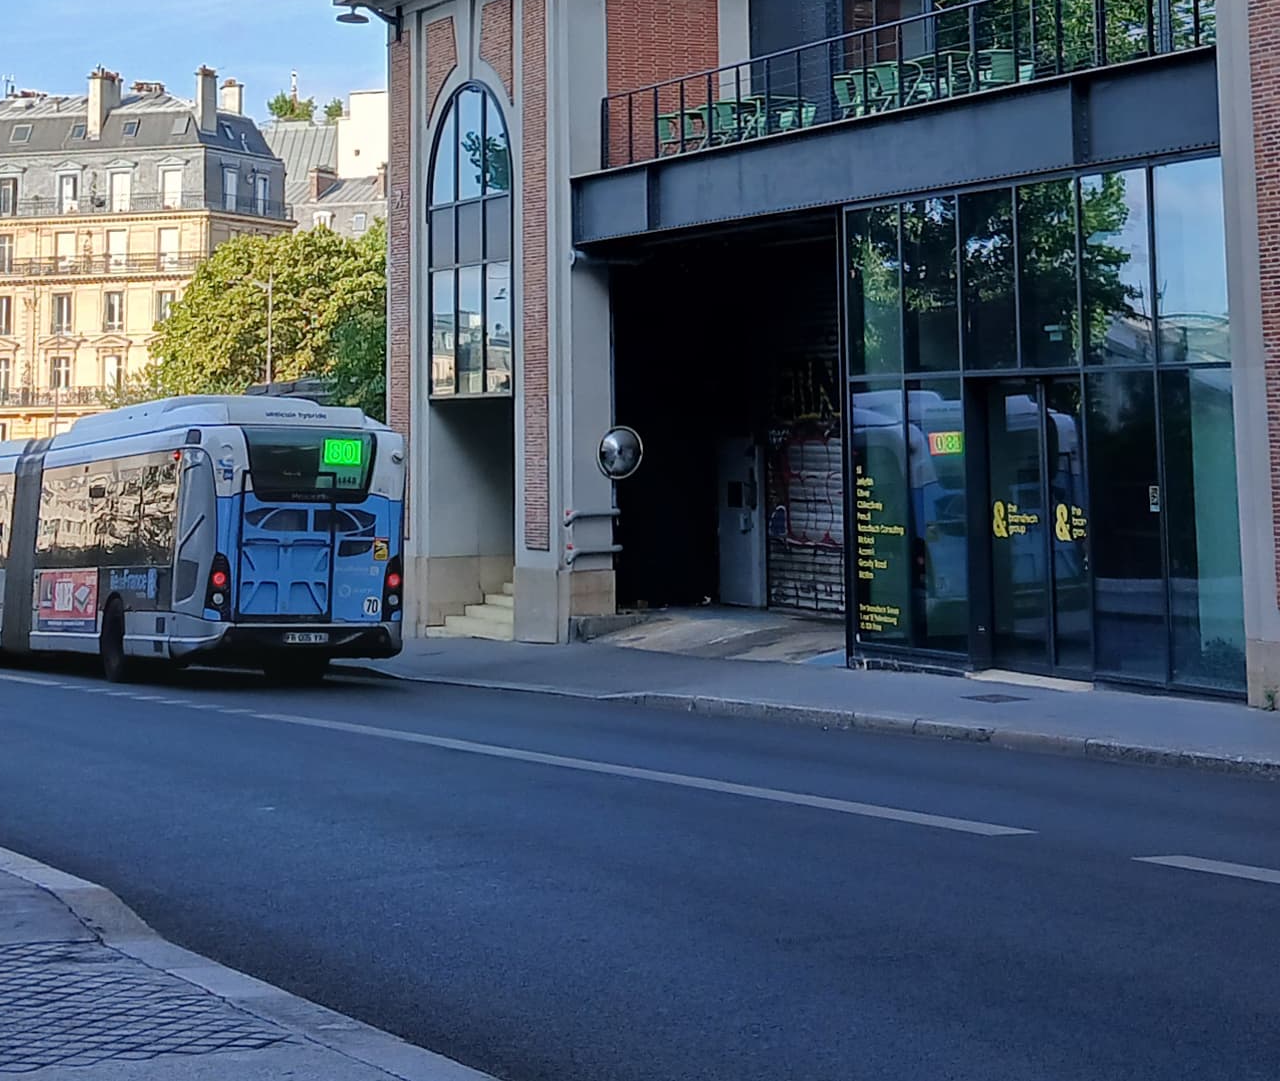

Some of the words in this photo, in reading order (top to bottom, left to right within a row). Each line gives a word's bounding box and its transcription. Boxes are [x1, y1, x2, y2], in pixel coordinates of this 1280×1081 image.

[329, 440, 356, 463] 80
[993, 501, 1008, 537] &
[1056, 504, 1072, 541] &
[366, 598, 378, 613] 70
